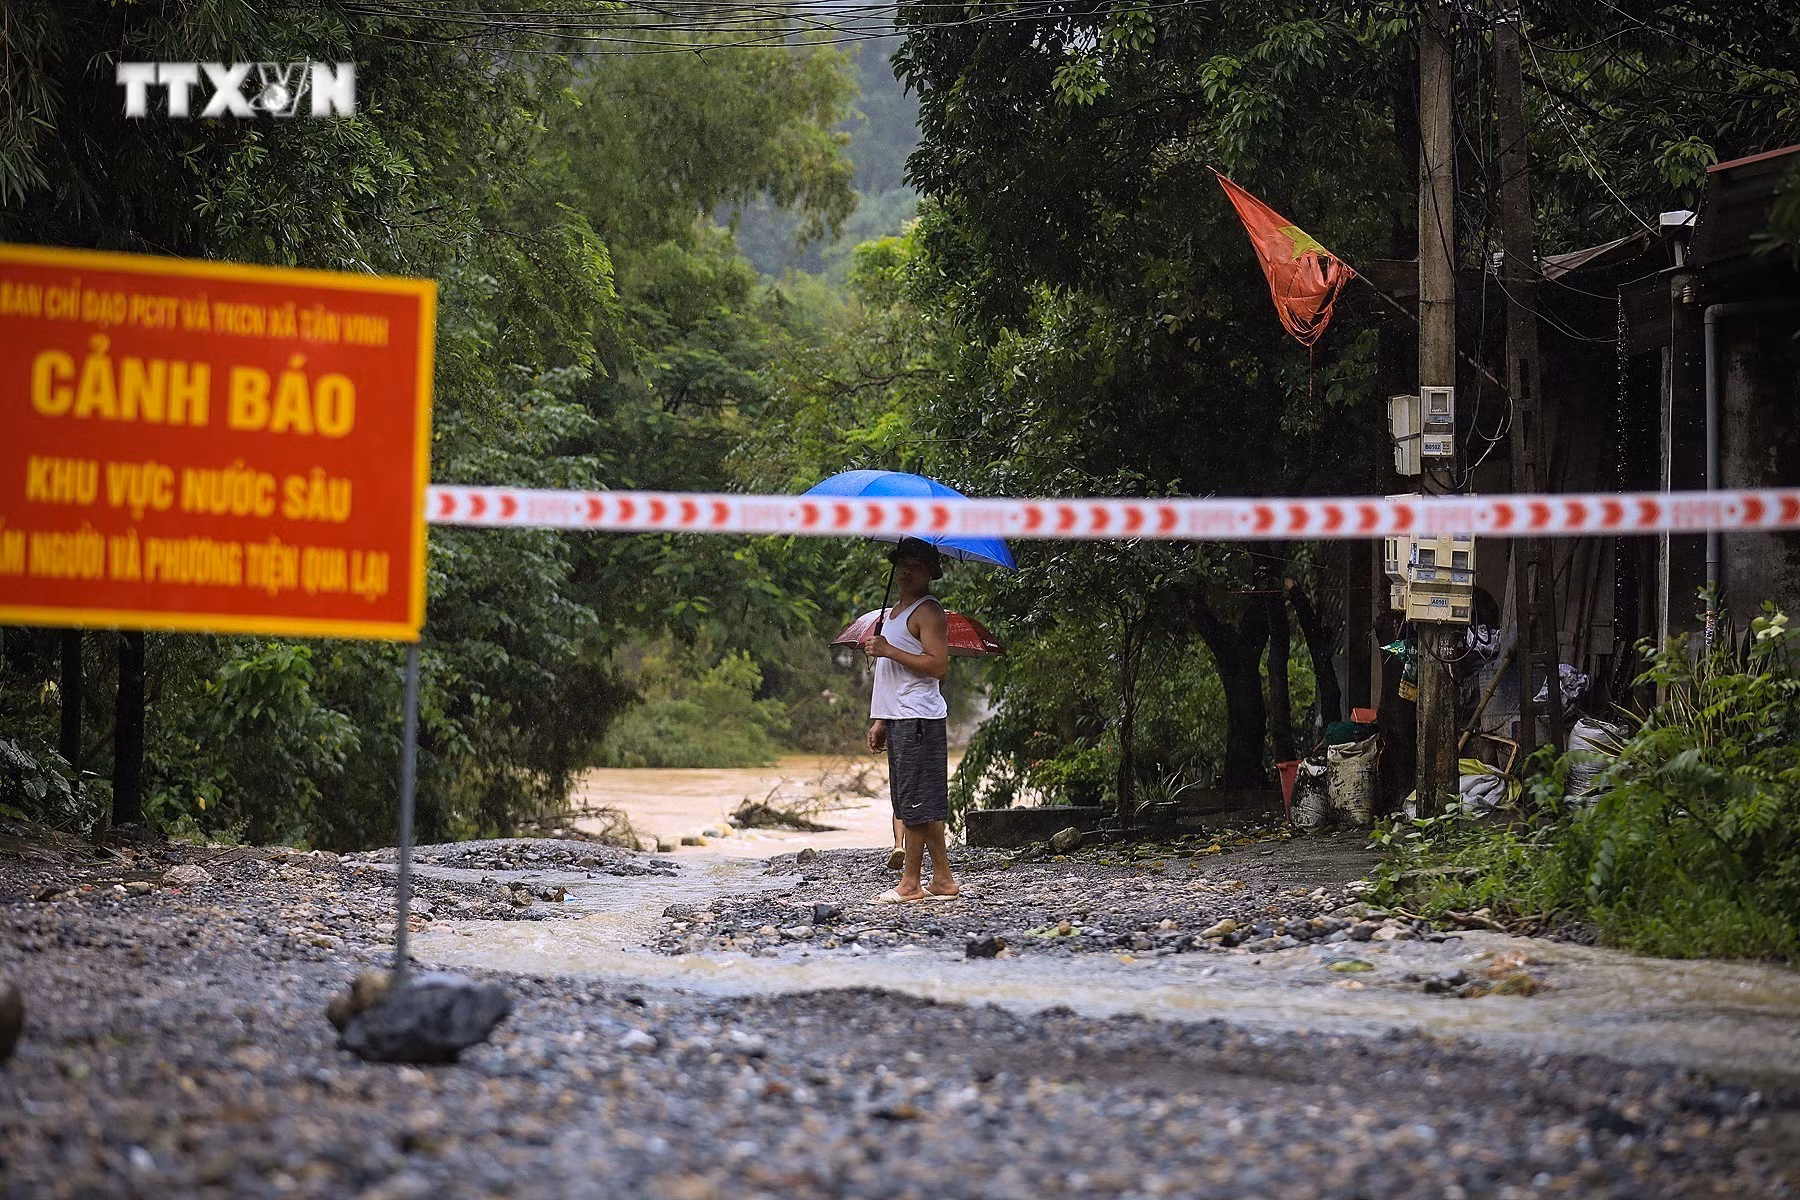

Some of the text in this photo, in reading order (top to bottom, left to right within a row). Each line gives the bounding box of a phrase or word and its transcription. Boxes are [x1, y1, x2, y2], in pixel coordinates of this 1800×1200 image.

[31, 333, 356, 438] CẢNH BÁO
[26, 455, 352, 523] KHU VỰC NƯỚC SÂU
